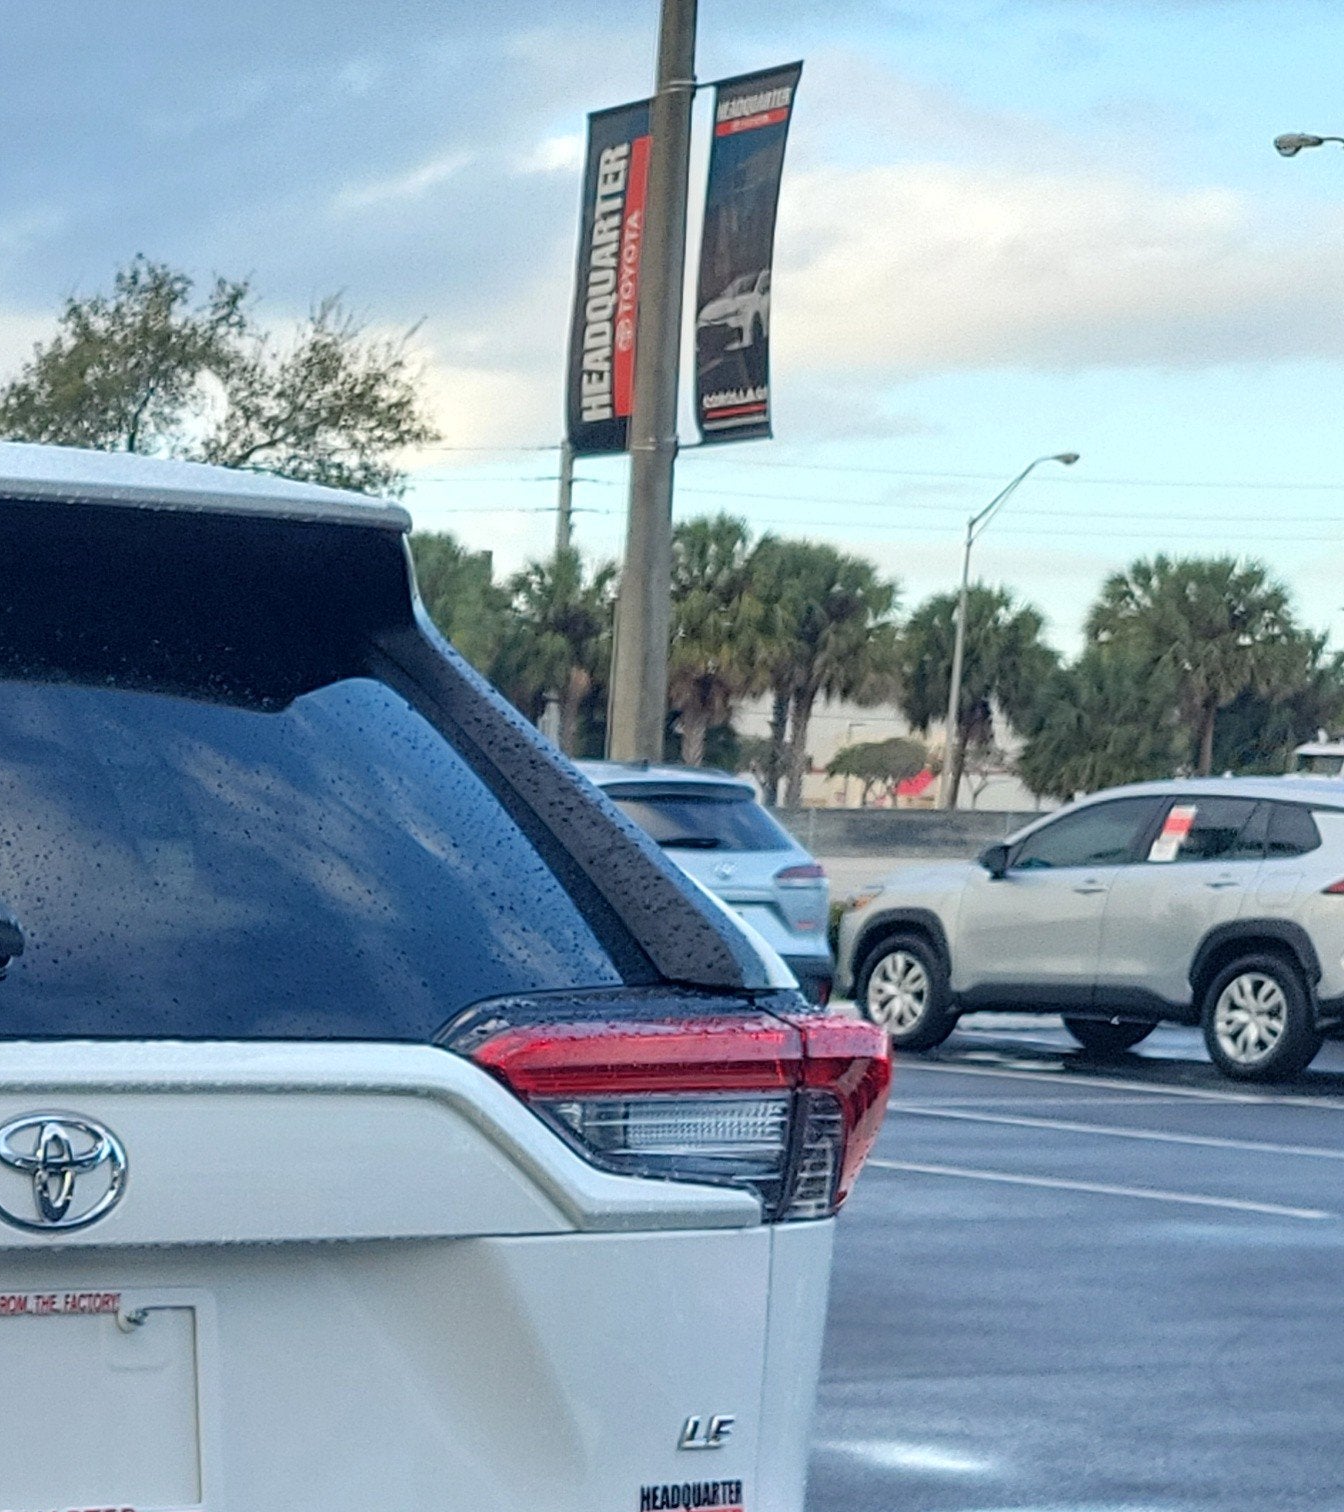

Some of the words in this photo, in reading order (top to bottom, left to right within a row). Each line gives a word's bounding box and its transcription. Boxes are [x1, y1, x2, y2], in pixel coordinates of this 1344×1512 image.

[617, 210, 642, 316] TOYOTA
[581, 142, 630, 422] HEADQUARTER
[34, 1294, 58, 1314] THE
[677, 1414, 736, 1450] LE
[640, 1479, 743, 1512] HEADQUARTER
